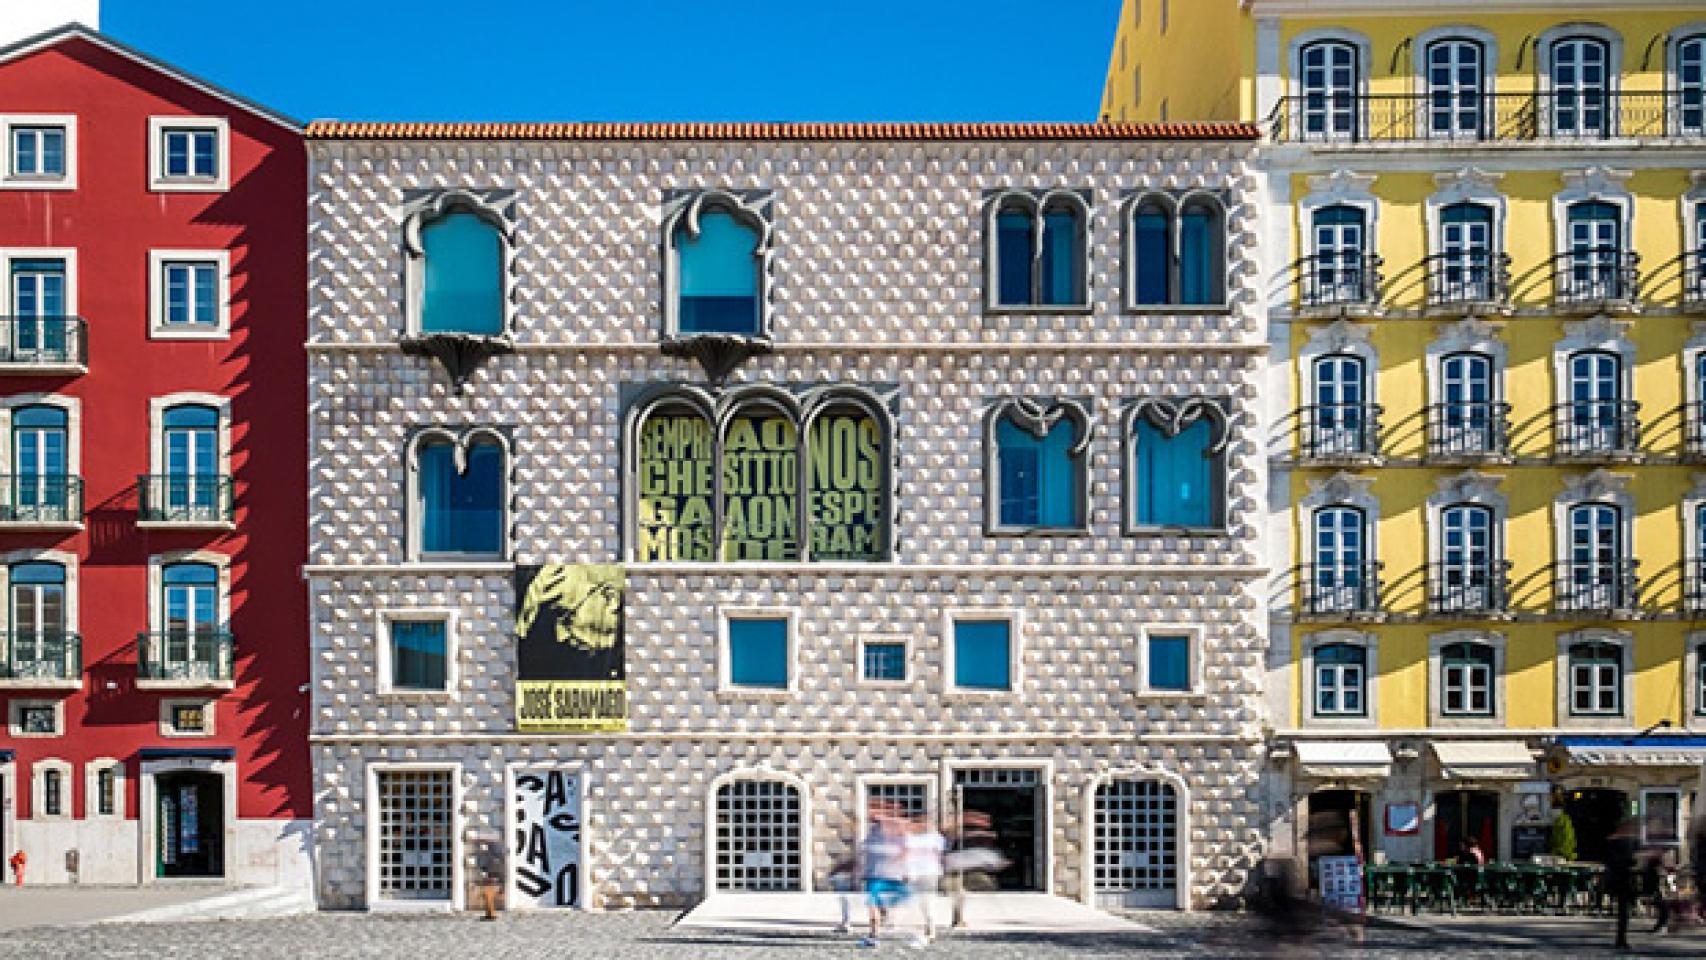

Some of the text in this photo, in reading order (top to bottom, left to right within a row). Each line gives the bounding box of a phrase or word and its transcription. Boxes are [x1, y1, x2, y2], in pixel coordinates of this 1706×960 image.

[726, 418, 796, 450] AO
[808, 417, 880, 488] NOS
[642, 460, 713, 494] CHE
[639, 496, 713, 525] GA
[726, 496, 796, 539] AON
[808, 491, 880, 524] ESPE
[554, 688, 624, 719] SARAMAGO
